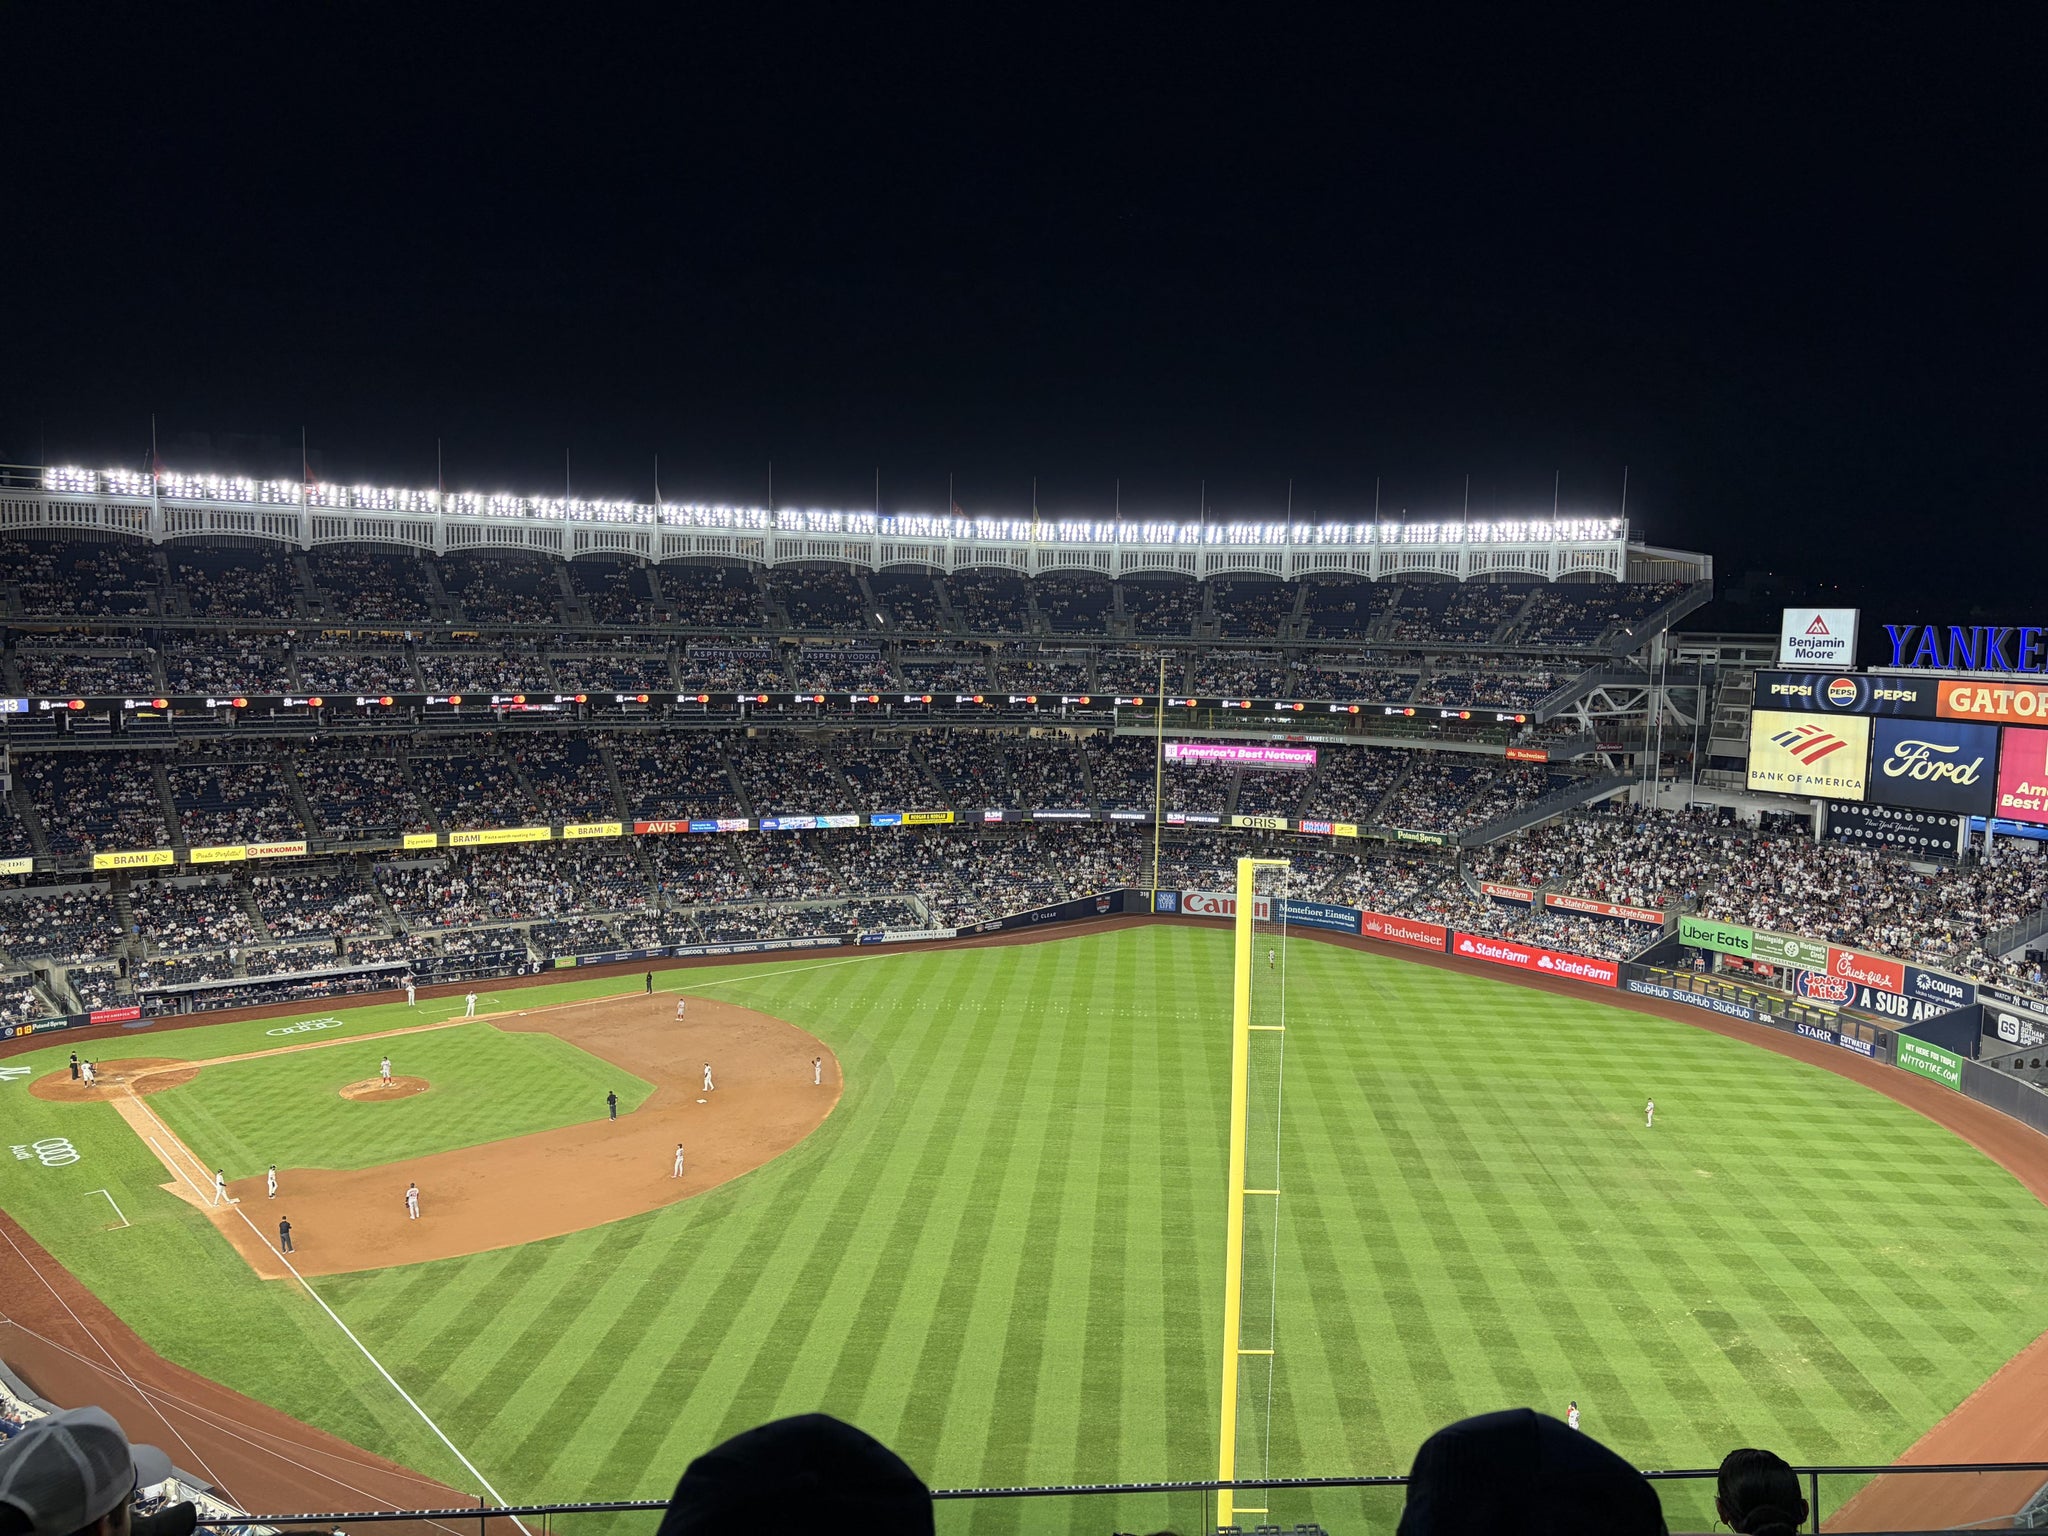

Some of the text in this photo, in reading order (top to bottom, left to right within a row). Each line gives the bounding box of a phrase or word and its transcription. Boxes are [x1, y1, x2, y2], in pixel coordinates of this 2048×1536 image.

[1789, 636, 1845, 649] Benjamin
[1883, 624, 2048, 672] YANKE
[807, 652, 836, 660] ASPEN
[1795, 648, 1834, 659] Moore
[1771, 684, 1812, 696] PEPSI
[1830, 688, 1855, 697] PEPSI
[1874, 689, 1917, 702] PEPSI
[1179, 747, 1237, 757] America's
[1238, 750, 1264, 759] Best
[1265, 751, 1313, 762] Network
[1517, 752, 1546, 760] Budweiser
[1883, 740, 1984, 786] Ford
[1751, 771, 1862, 789] BANK OF AMERICA
[2001, 794, 2041, 810] Best
[647, 822, 676, 833] AVIS
[1242, 817, 1277, 828] ORIS
[1864, 818, 1920, 833] New York Yankees
[578, 827, 603, 835] BRAMI
[1398, 831, 1442, 845] Poland Spring
[453, 834, 480, 843] BRAMI
[260, 845, 304, 854] KIKKOMAN
[113, 855, 148, 865] BRAMI
[1183, 893, 1268, 918] Cann
[1279, 903, 1323, 917] Montefiore
[1325, 909, 1355, 922] Einstein
[1683, 925, 1715, 942] Uber
[1717, 932, 1749, 949] Eats
[1755, 932, 1784, 944] Morningside
[1810, 950, 1825, 960] Circle
[1837, 957, 1893, 988] Chick-fil-A
[1805, 971, 1849, 990] Jersey
[1931, 979, 1963, 999] coupa
[1630, 982, 1750, 1019] StubHub StubHub StubHub
[1860, 988, 1871, 1009] A
[1876, 991, 1908, 1018] SUB
[1994, 991, 2011, 1002] WATCH
[33, 1020, 67, 1031] Poland Spring
[2001, 1020, 2016, 1036] GS
[2021, 1020, 2033, 1030] THE
[1797, 1023, 1832, 1042] STARR
[2020, 1032, 2043, 1045] SPORTS
[2021, 1026, 2045, 1040] GOTHAM
[1840, 1034, 1871, 1051] CUTWATER
[2020, 1037, 2032, 1046] APP
[1905, 1042, 1956, 1069] HIT HERE FOR TRIPLE
[1901, 1053, 1958, 1085] NITTOTIRE.COM
